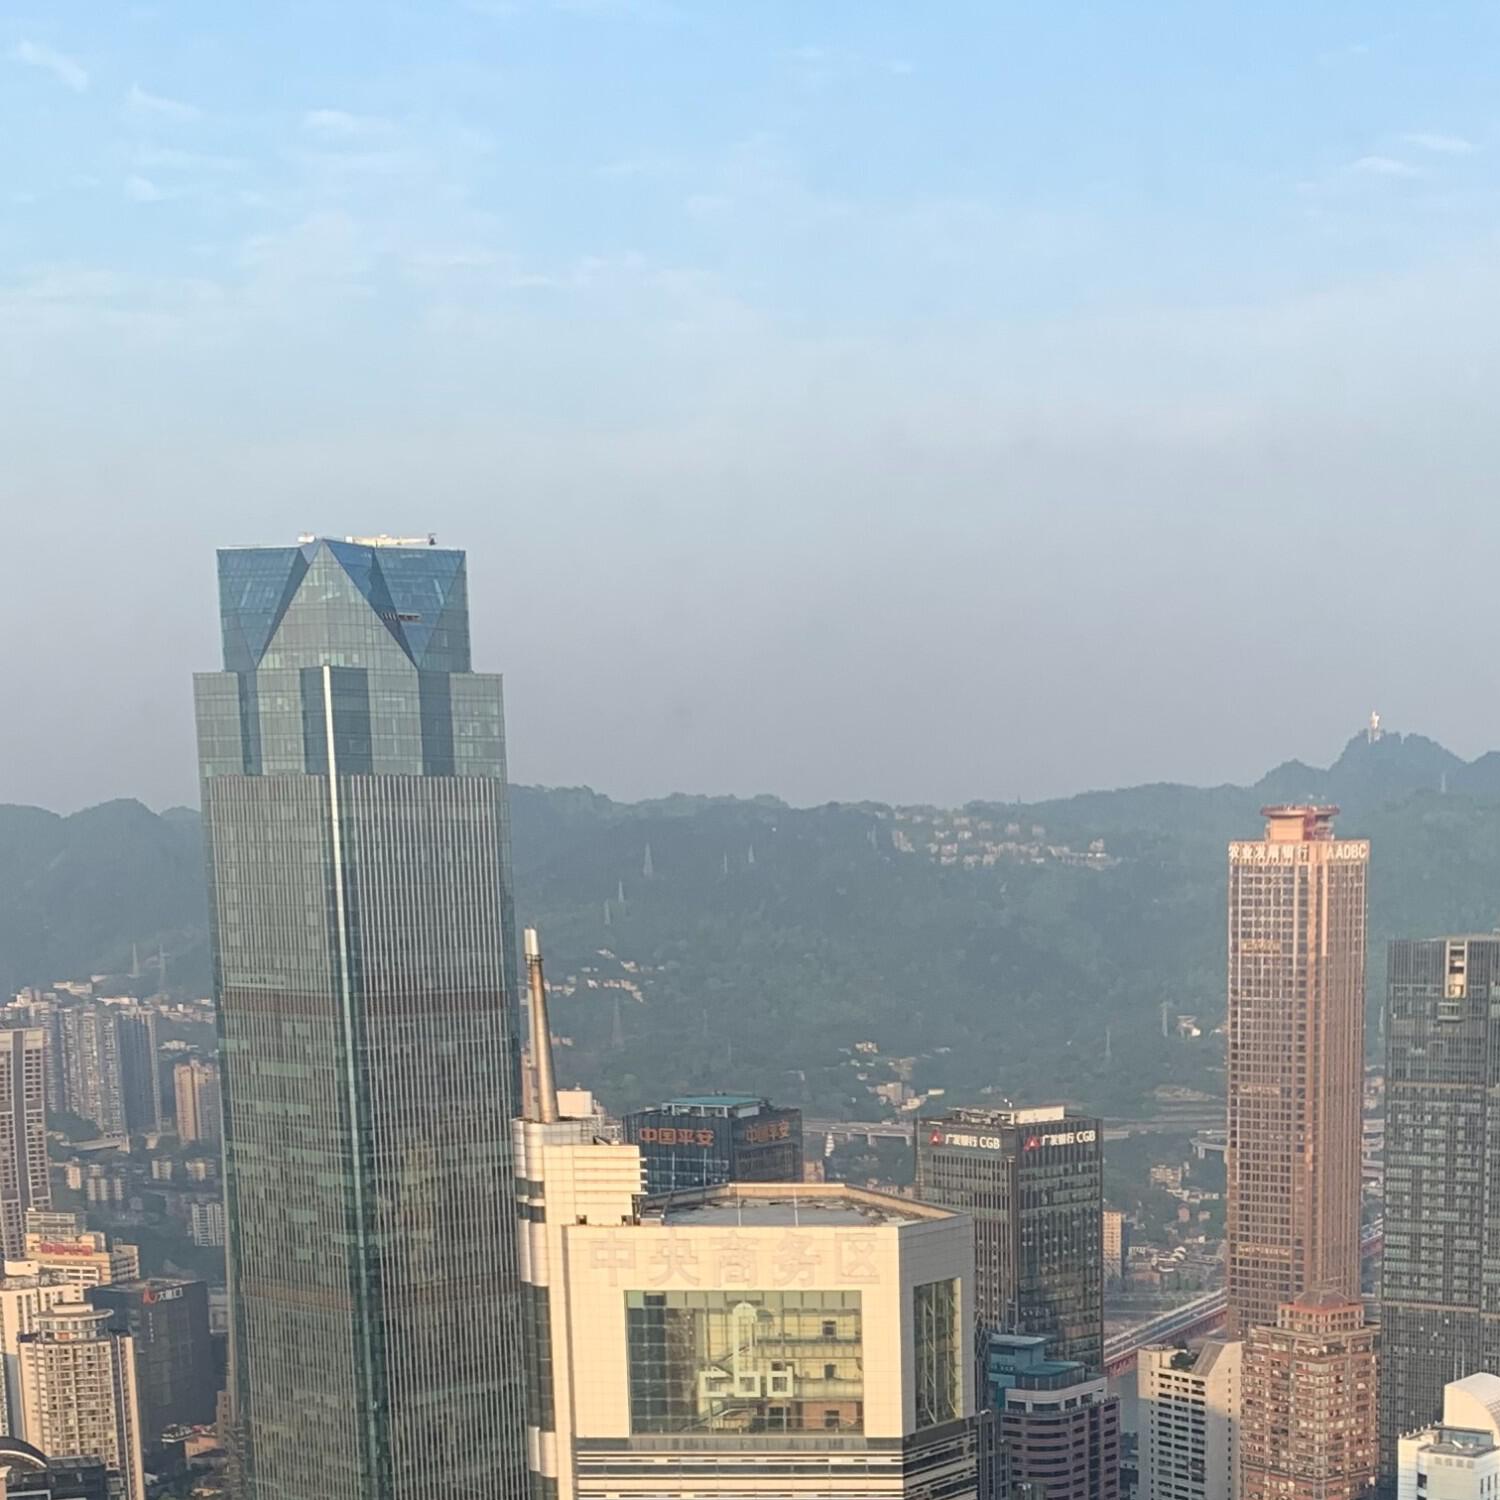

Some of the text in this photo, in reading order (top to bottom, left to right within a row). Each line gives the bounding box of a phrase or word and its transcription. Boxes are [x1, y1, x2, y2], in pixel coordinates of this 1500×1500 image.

[639, 1127, 714, 1147] 中国平安
[979, 1136, 1000, 1150] CGB
[1076, 1130, 1097, 1144] CGB
[590, 1231, 880, 1287] 中央商务区
